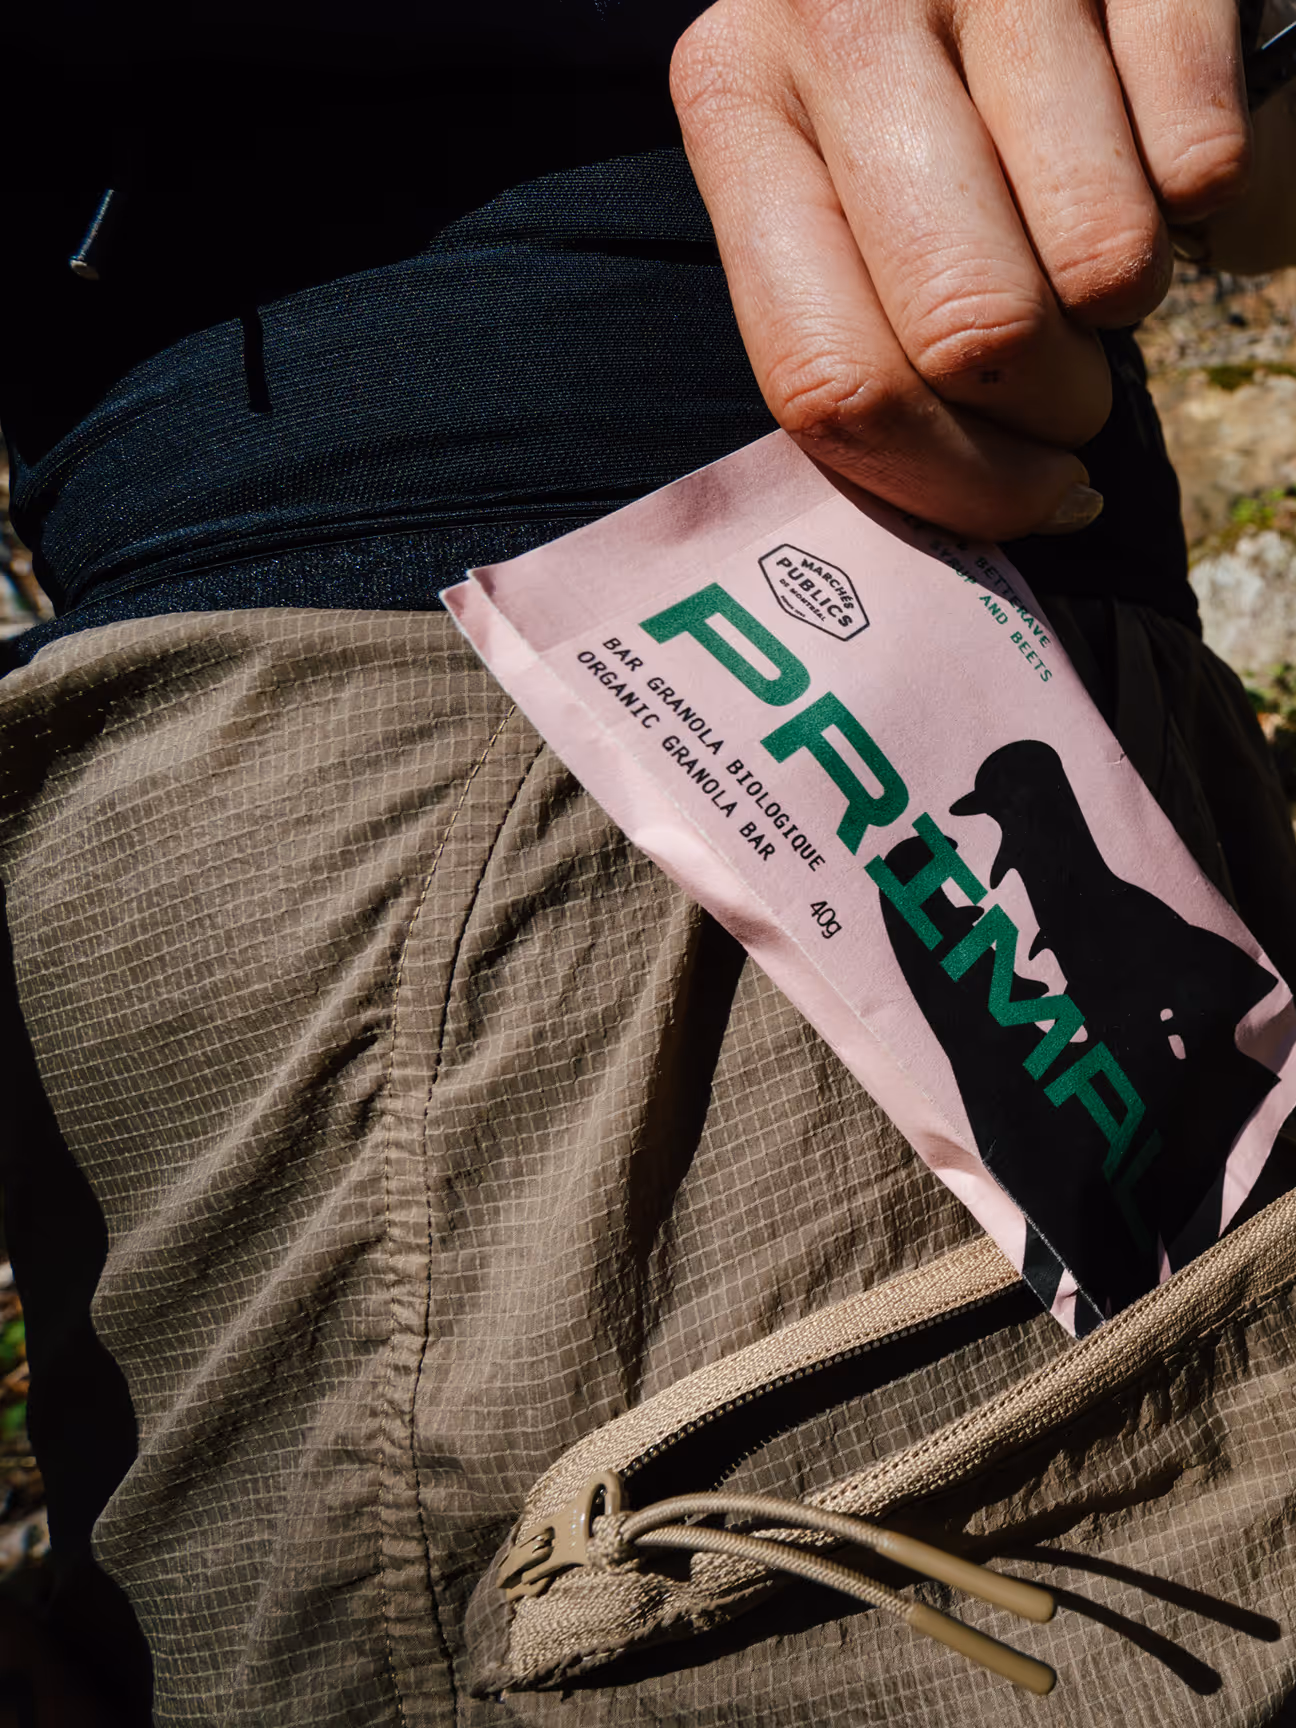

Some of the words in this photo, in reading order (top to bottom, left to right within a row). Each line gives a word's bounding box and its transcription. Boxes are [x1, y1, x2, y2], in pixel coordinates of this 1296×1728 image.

[776, 557, 853, 627] PUBLICS
[801, 558, 855, 609] MARCHÉS
[974, 556, 1051, 648] BETTERAVE
[979, 595, 1008, 625] AND
[1010, 631, 1053, 682] BEETS
[576, 650, 660, 729] ORGANIC
[662, 735, 738, 818] GRANOLA
[739, 821, 776, 861] BAR
[603, 637, 644, 672] BAR
[647, 676, 725, 755] GRANOLA
[726, 758, 826, 872] BIOLOGIQUE
[810, 899, 842, 939] 40g
